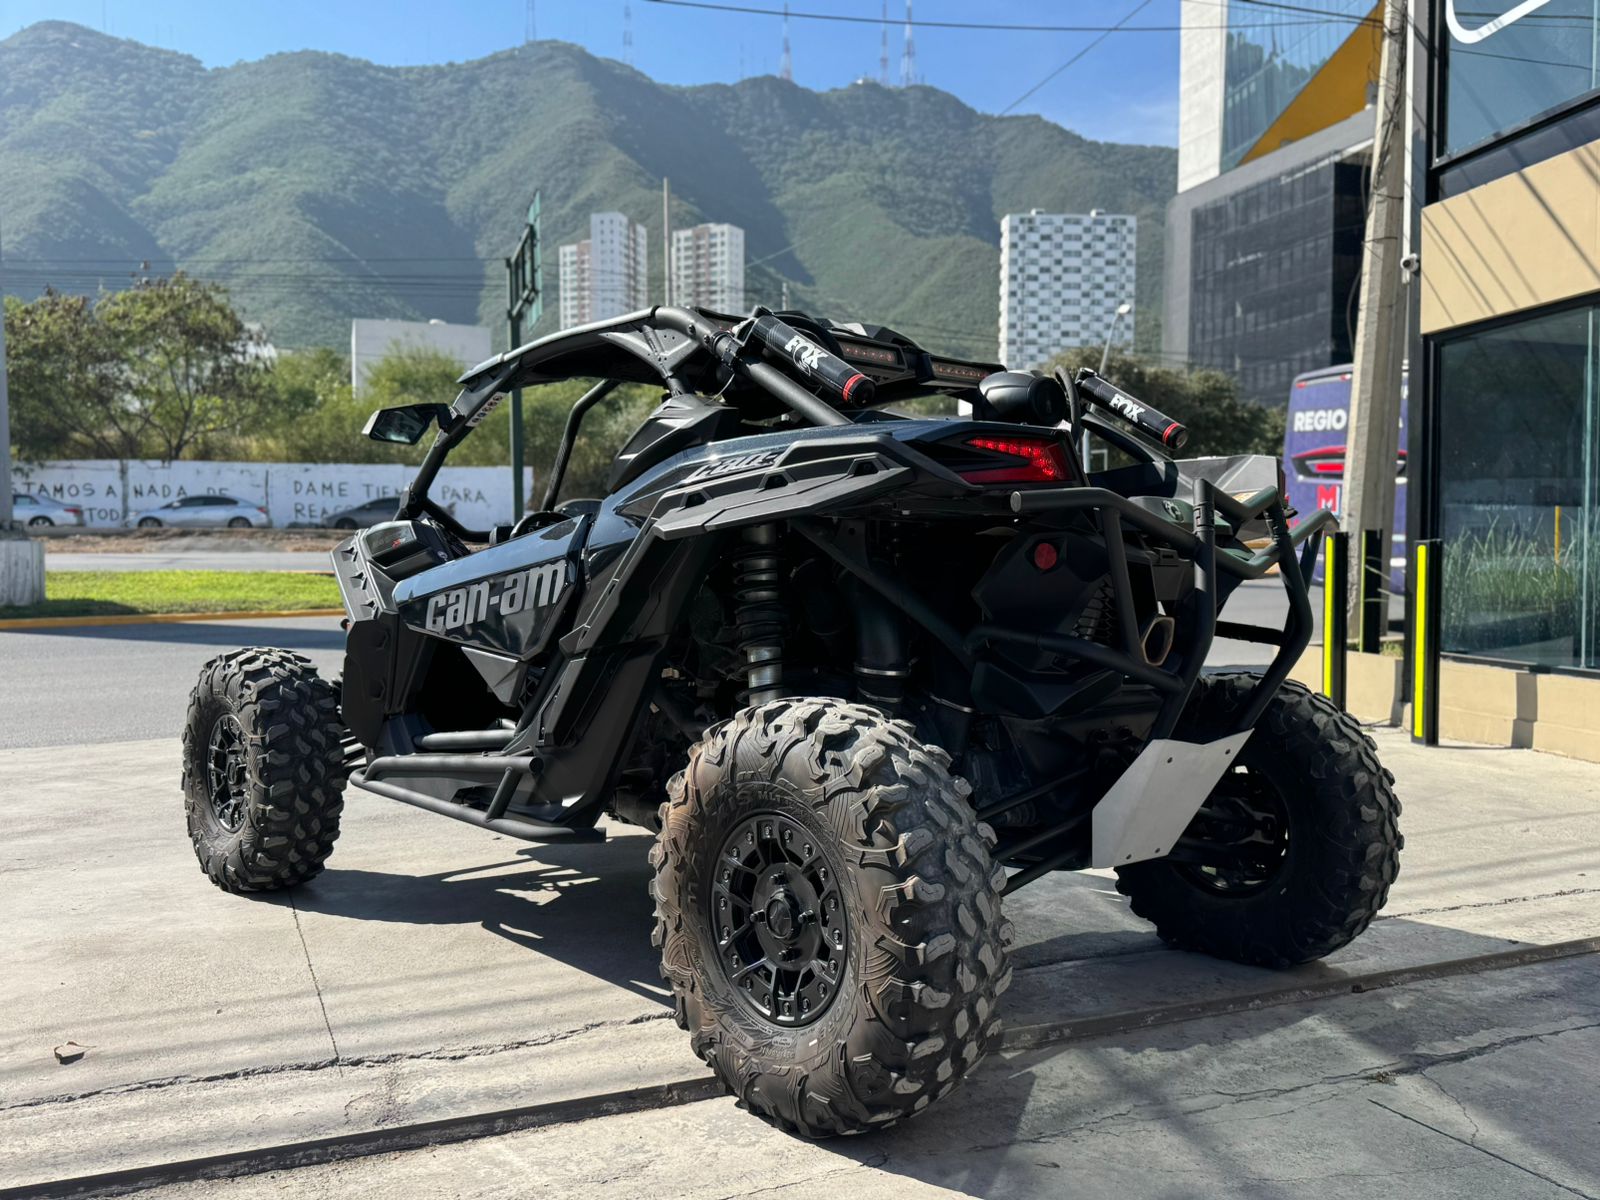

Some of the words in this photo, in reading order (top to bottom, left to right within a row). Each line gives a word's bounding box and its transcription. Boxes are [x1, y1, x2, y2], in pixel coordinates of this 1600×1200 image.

[784, 335, 828, 370] FOX
[1109, 393, 1145, 423] FOX
[1293, 408, 1347, 432] REGIO
[105, 485, 117, 498] A
[133, 484, 188, 498] NADA
[294, 481, 349, 498] DAME
[442, 486, 487, 503] PARA
[425, 563, 567, 633] can-am
